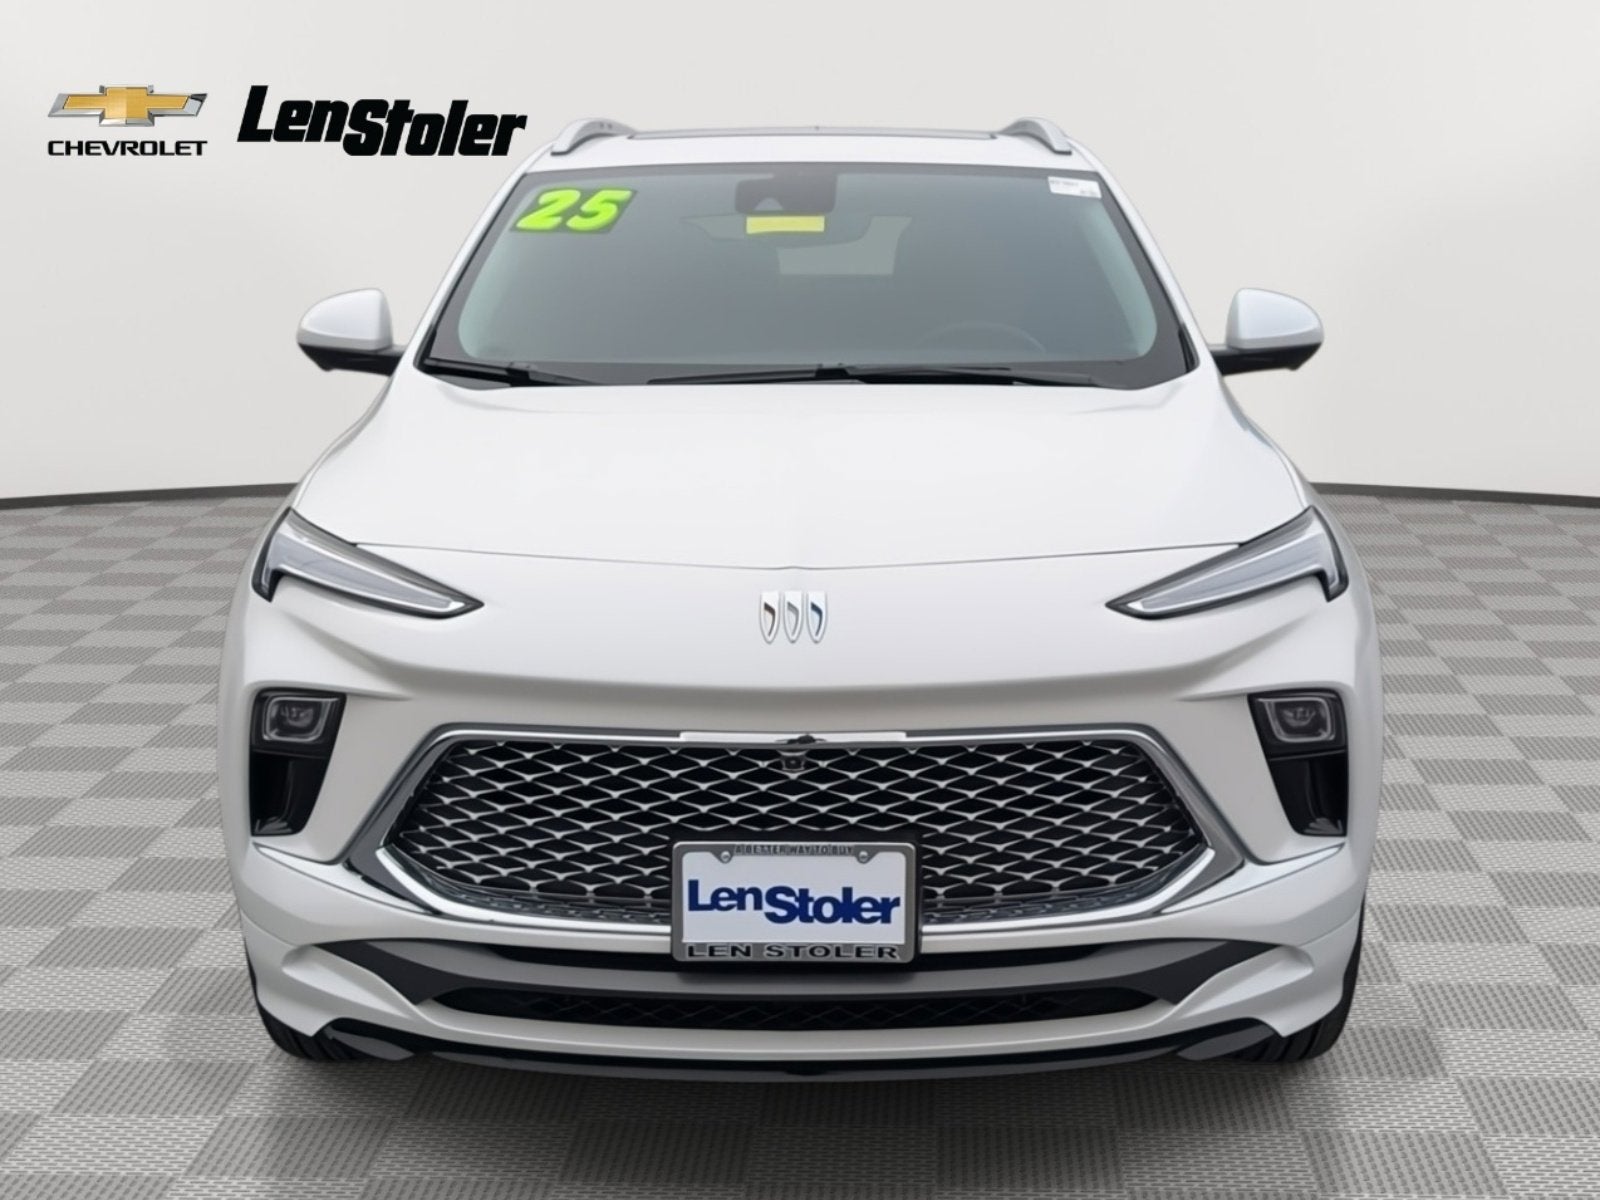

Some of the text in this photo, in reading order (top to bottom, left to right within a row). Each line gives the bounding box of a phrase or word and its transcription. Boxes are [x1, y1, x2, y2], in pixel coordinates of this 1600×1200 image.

[516, 189, 632, 231] 25
[687, 945, 899, 959] LEN STOLER
